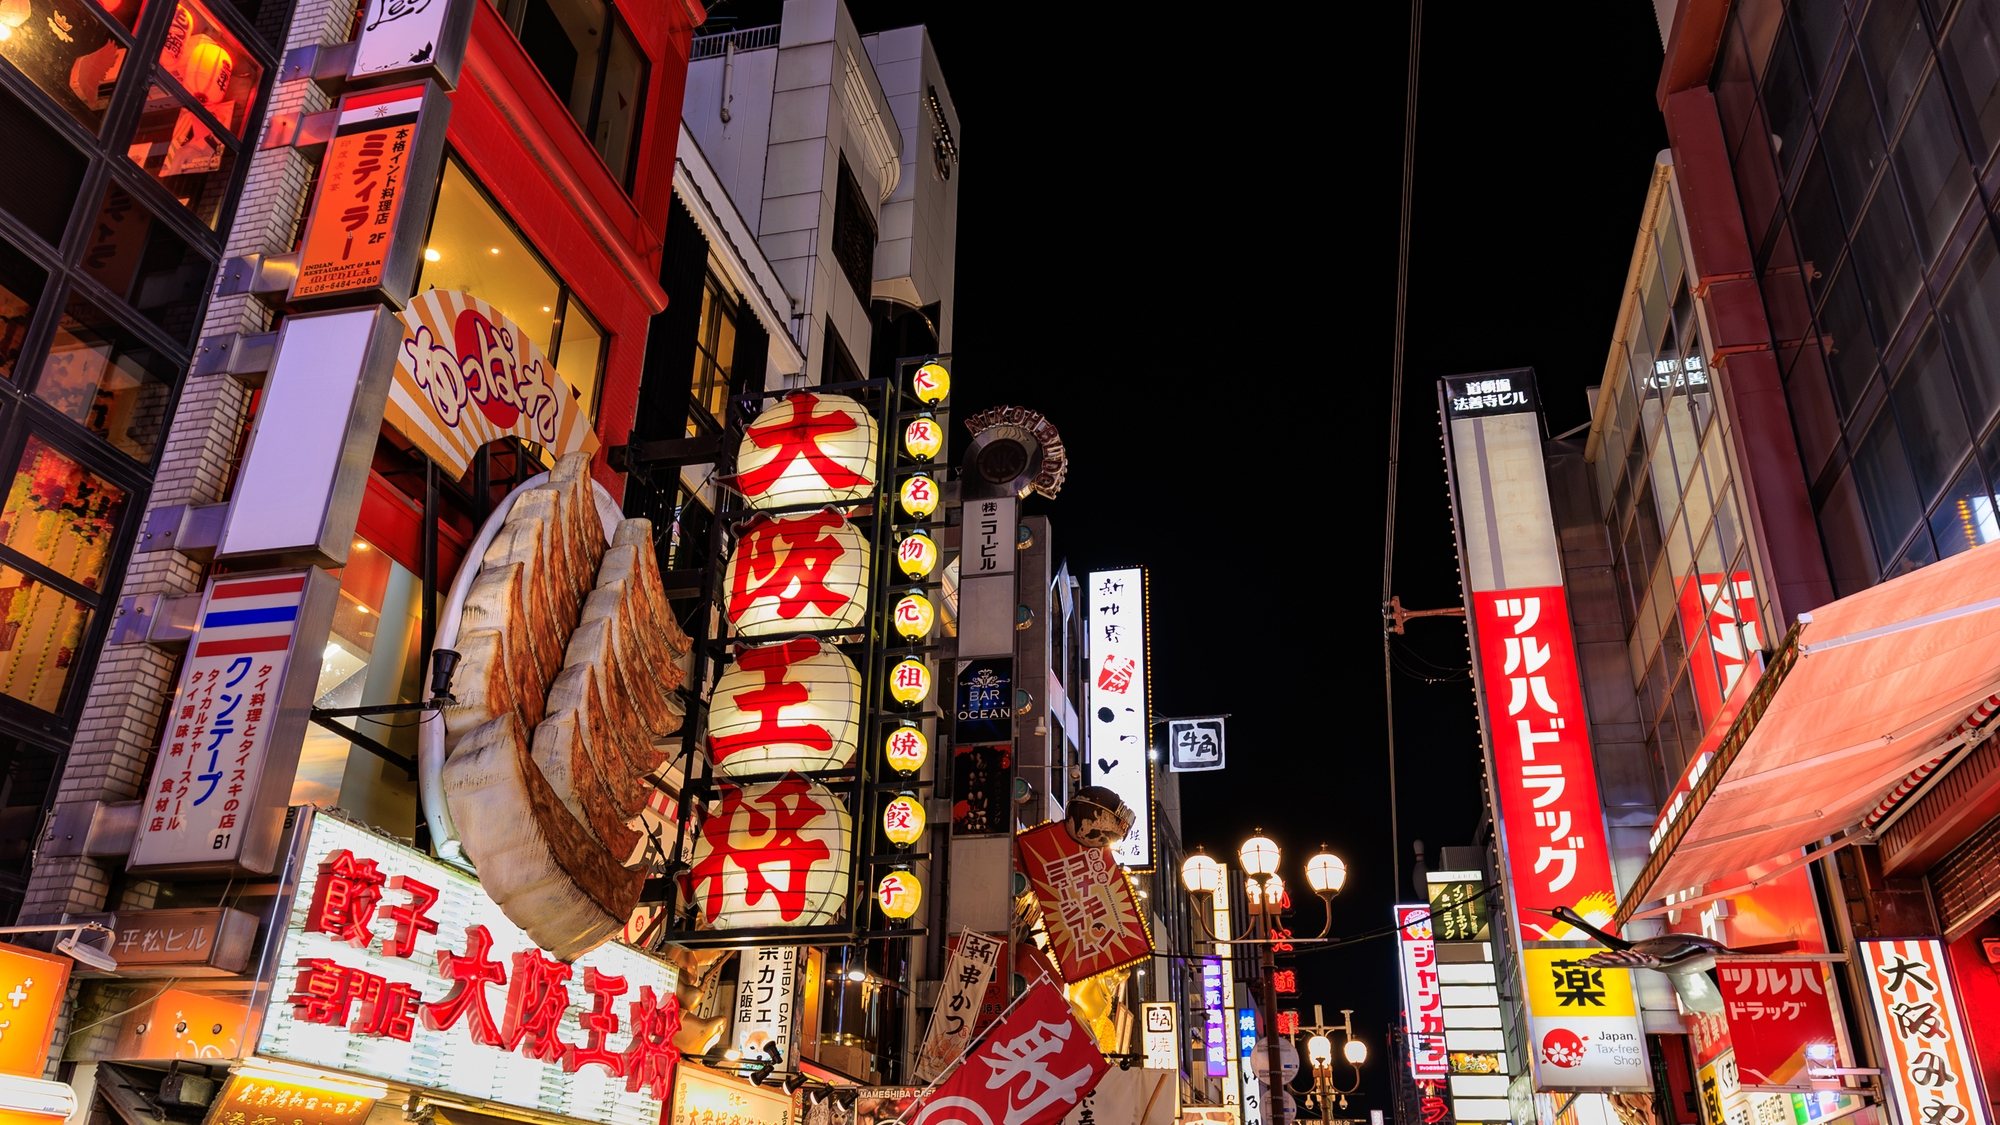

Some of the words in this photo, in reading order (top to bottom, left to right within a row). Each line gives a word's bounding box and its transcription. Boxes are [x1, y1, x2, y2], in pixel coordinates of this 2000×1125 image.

[374, 129, 409, 225] 本格インド料理店
[341, 134, 387, 261] ミティラー
[368, 232, 386, 244] 2F
[304, 264, 355, 276] RESTAURANT
[305, 262, 333, 271] INDIAN
[1454, 392, 1528, 411] 法善寺ビル
[965, 405, 1044, 436] NIKOH
[879, 368, 935, 906] 大阪名物元祖焼餃子
[675, 390, 875, 925] 大阪王将
[969, 690, 1000, 701] BAR
[194, 657, 252, 807] クンテープ
[958, 708, 1010, 721] OCEAN
[167, 669, 220, 830] タイカルチャースクール
[218, 664, 272, 829] タイ料理とタイスキの店
[1179, 731, 1217, 757] 牛角
[1494, 597, 1584, 893] ツルハドラッグ
[148, 778, 175, 832] 食材店
[212, 834, 231, 850] B1
[304, 848, 440, 958] 餃子
[1046, 861, 1097, 957] ミュージアム
[118, 927, 208, 954] 平松ビル
[1551, 959, 1606, 1007] 薬
[1722, 968, 1823, 996] ツルハ
[288, 958, 422, 1043] 専門店
[419, 924, 682, 1101] 大阪王将
[739, 980, 754, 1023] 大阪店
[1413, 944, 1446, 1061] ジャンカラ
[1729, 1001, 1807, 1021] ドラッグ
[777, 1003, 788, 1044] CAFE
[1150, 1010, 1171, 1027] 牛角
[1239, 1015, 1256, 1050] 焼肉
[1596, 1044, 1639, 1054] Tax-free
[1599, 1031, 1637, 1043] Japan.
[1614, 1056, 1641, 1067] Shop
[859, 1089, 911, 1100] MAMESHIBA
